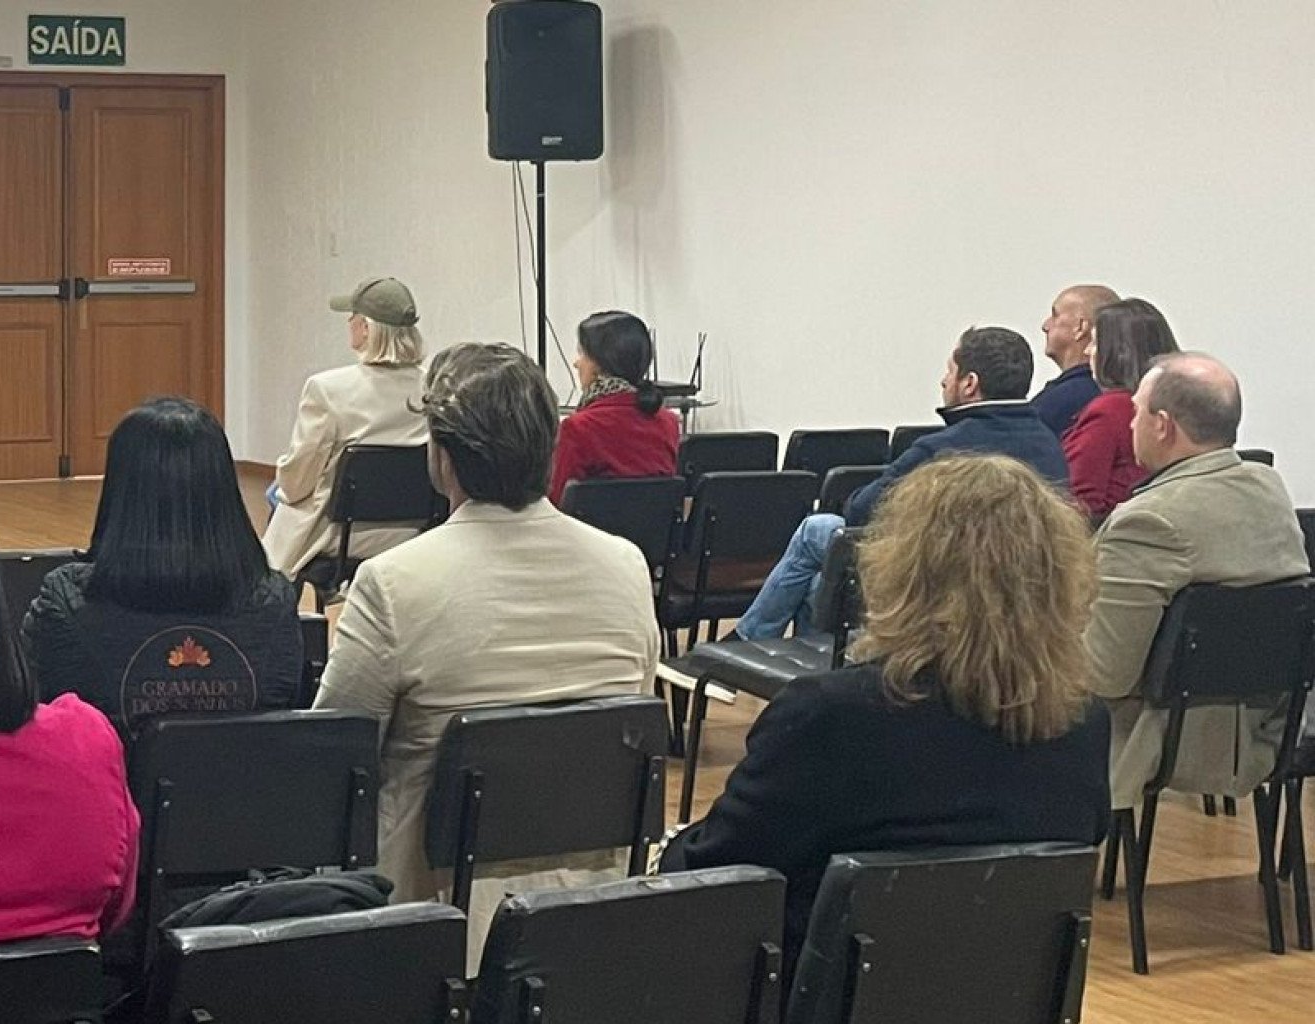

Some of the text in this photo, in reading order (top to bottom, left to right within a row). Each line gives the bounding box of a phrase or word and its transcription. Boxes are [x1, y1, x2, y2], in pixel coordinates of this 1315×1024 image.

[30, 19, 123, 56] SAÍDA
[142, 680, 237, 697] GRAMADO
[133, 698, 169, 713] DOS
